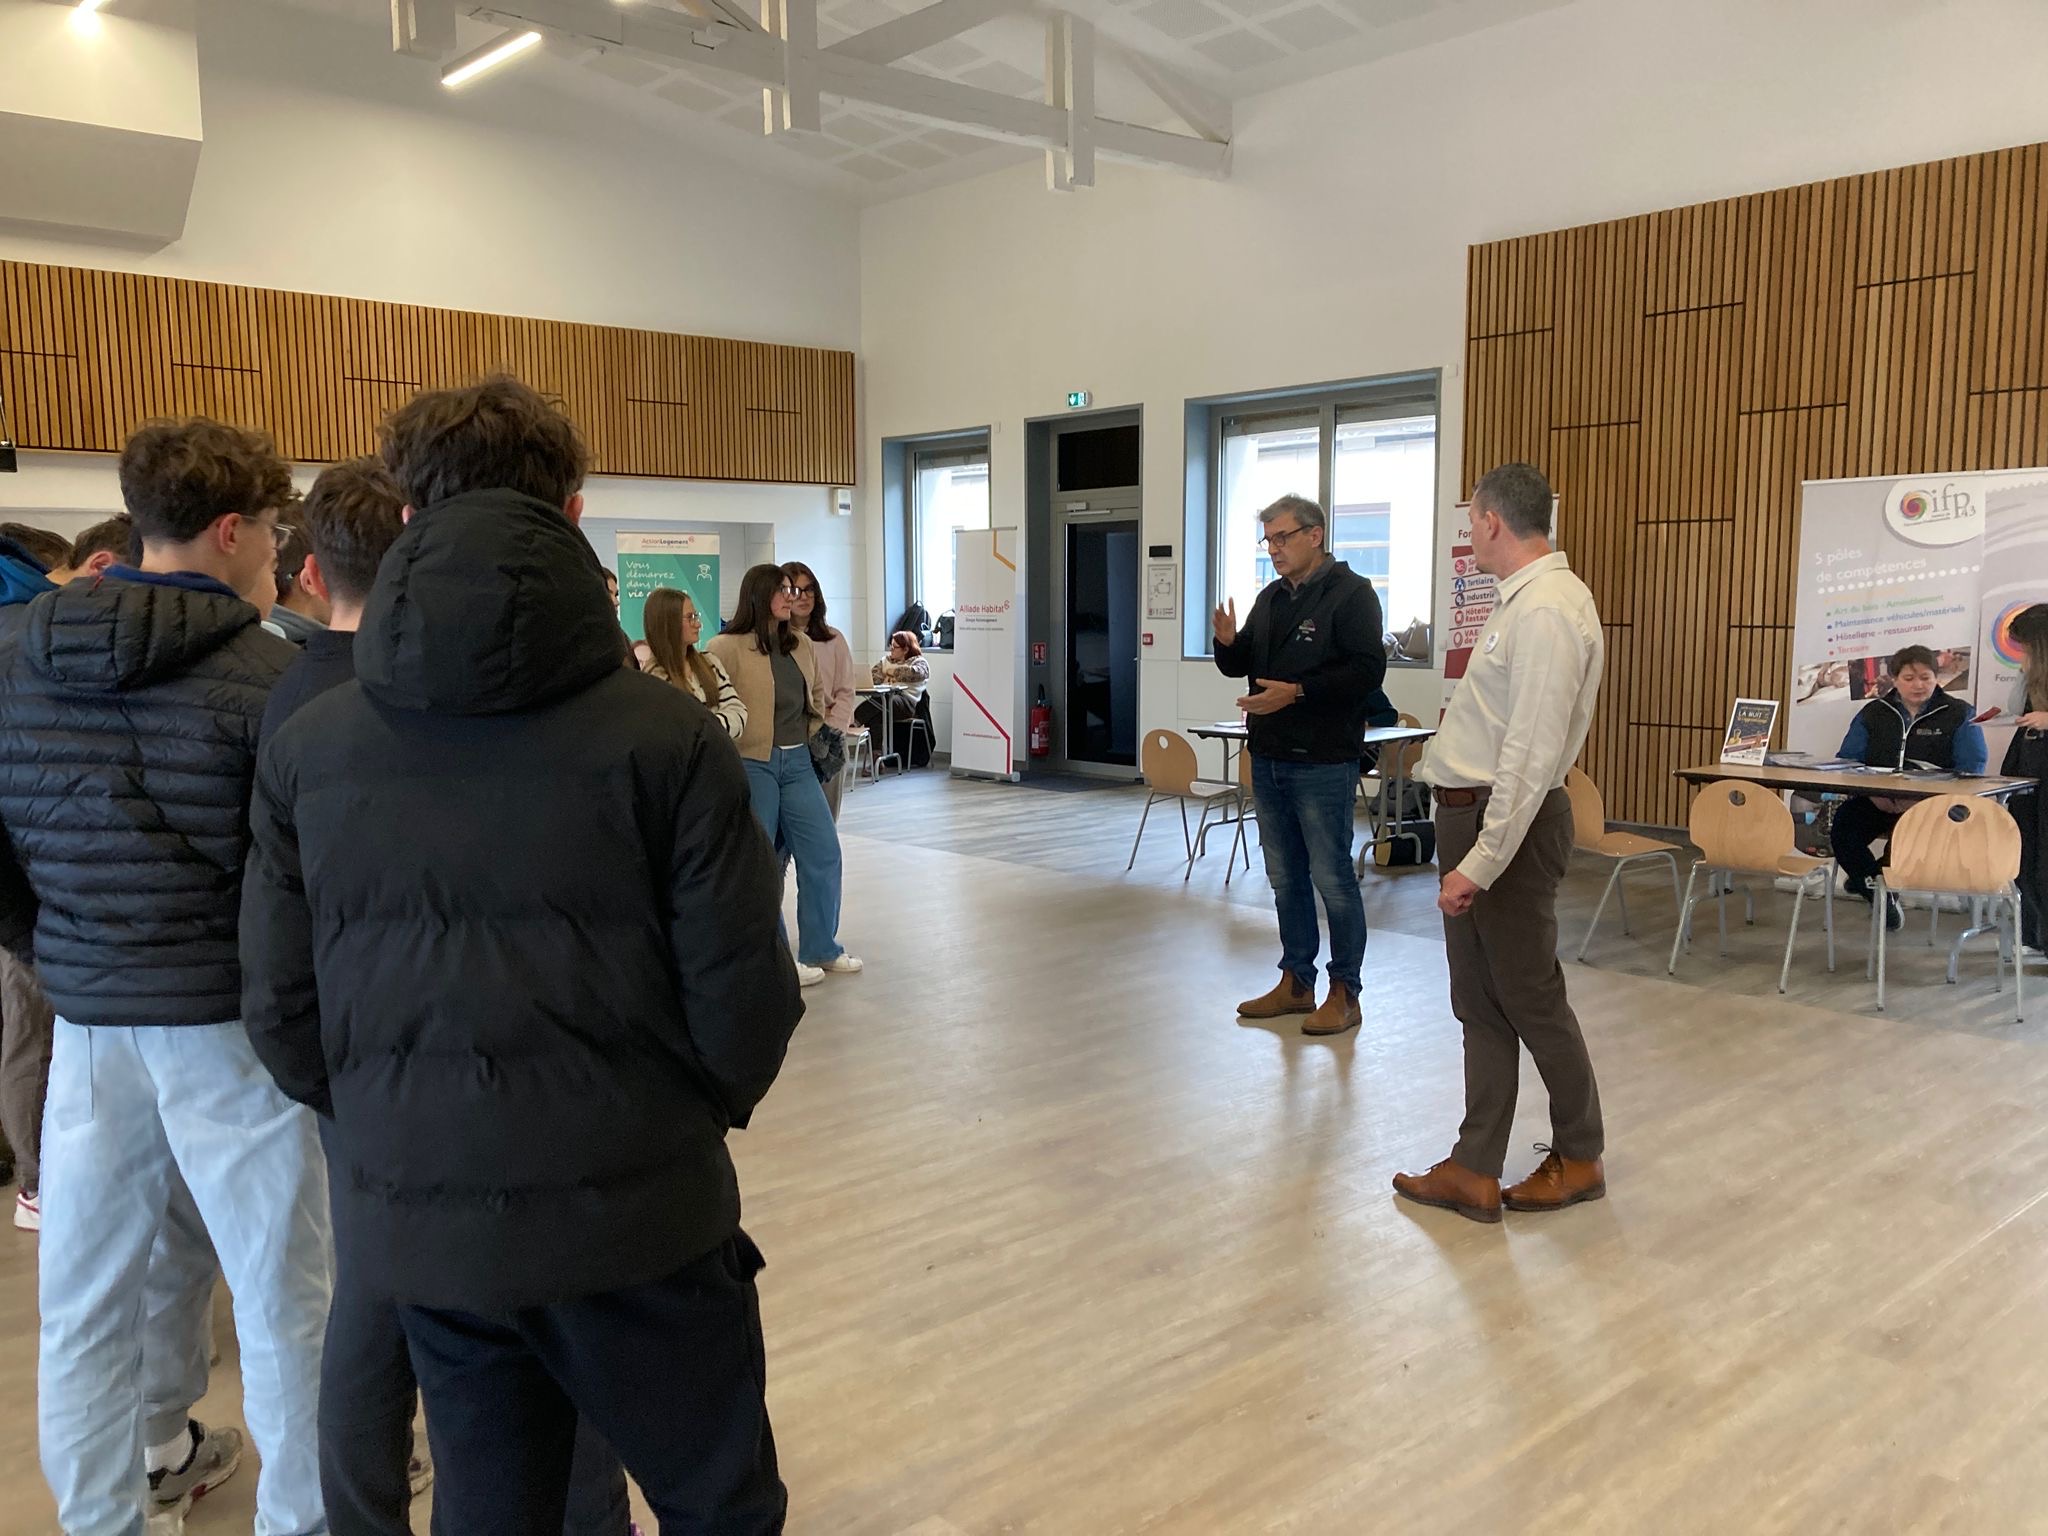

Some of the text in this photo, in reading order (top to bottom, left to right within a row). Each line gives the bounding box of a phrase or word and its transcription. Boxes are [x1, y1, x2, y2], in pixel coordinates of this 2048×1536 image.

[1815, 548, 1863, 566] 5 pôles
[626, 560, 650, 570] Vous
[626, 569, 675, 579] démarrez
[1816, 557, 1927, 584] de compétences
[626, 580, 651, 589] dans
[1467, 577, 1494, 588] Tertiaire
[628, 590, 645, 599] vie
[960, 604, 1004, 613] Alliade Habitat
[1834, 615, 1884, 629] Maintenance
[1883, 623, 1934, 636] restauration
